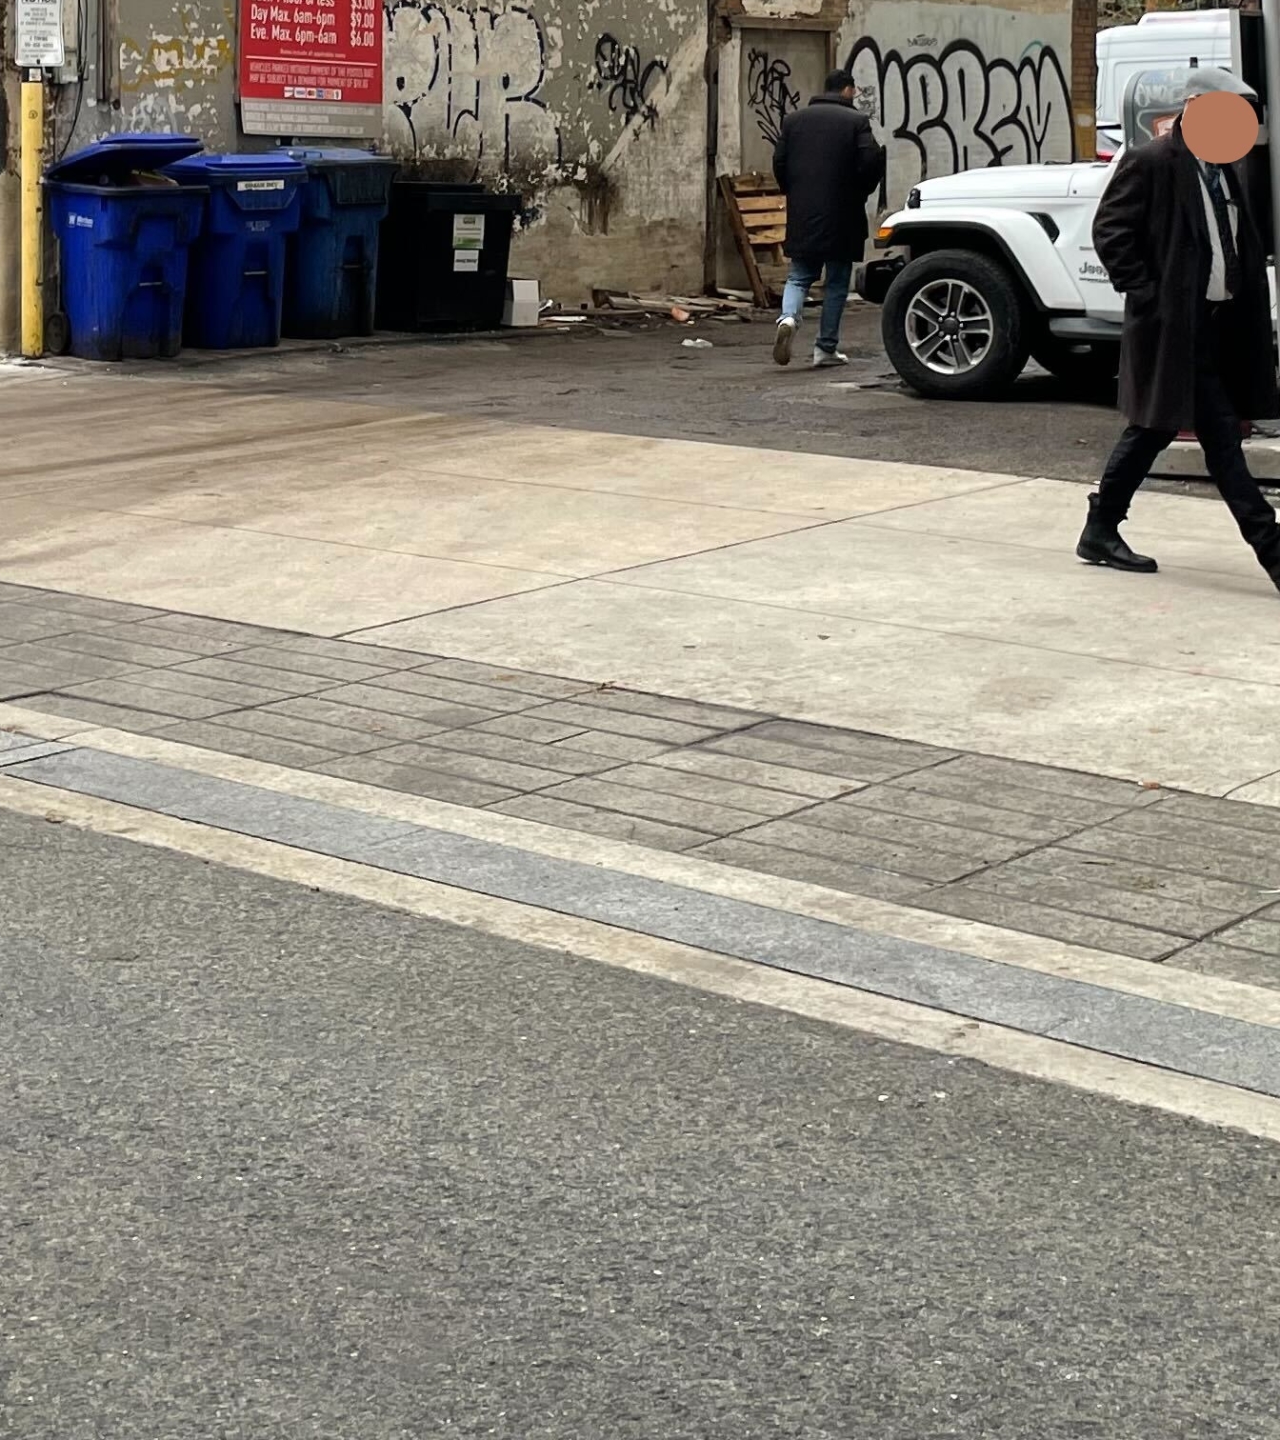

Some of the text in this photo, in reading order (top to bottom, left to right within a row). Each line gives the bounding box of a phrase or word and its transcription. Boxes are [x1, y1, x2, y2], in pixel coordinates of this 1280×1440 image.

[251, 4, 374, 29] Day Max. 6am-6pm $9.00
[250, 25, 374, 47] Eve. Max. 6pm-6am $6.00
